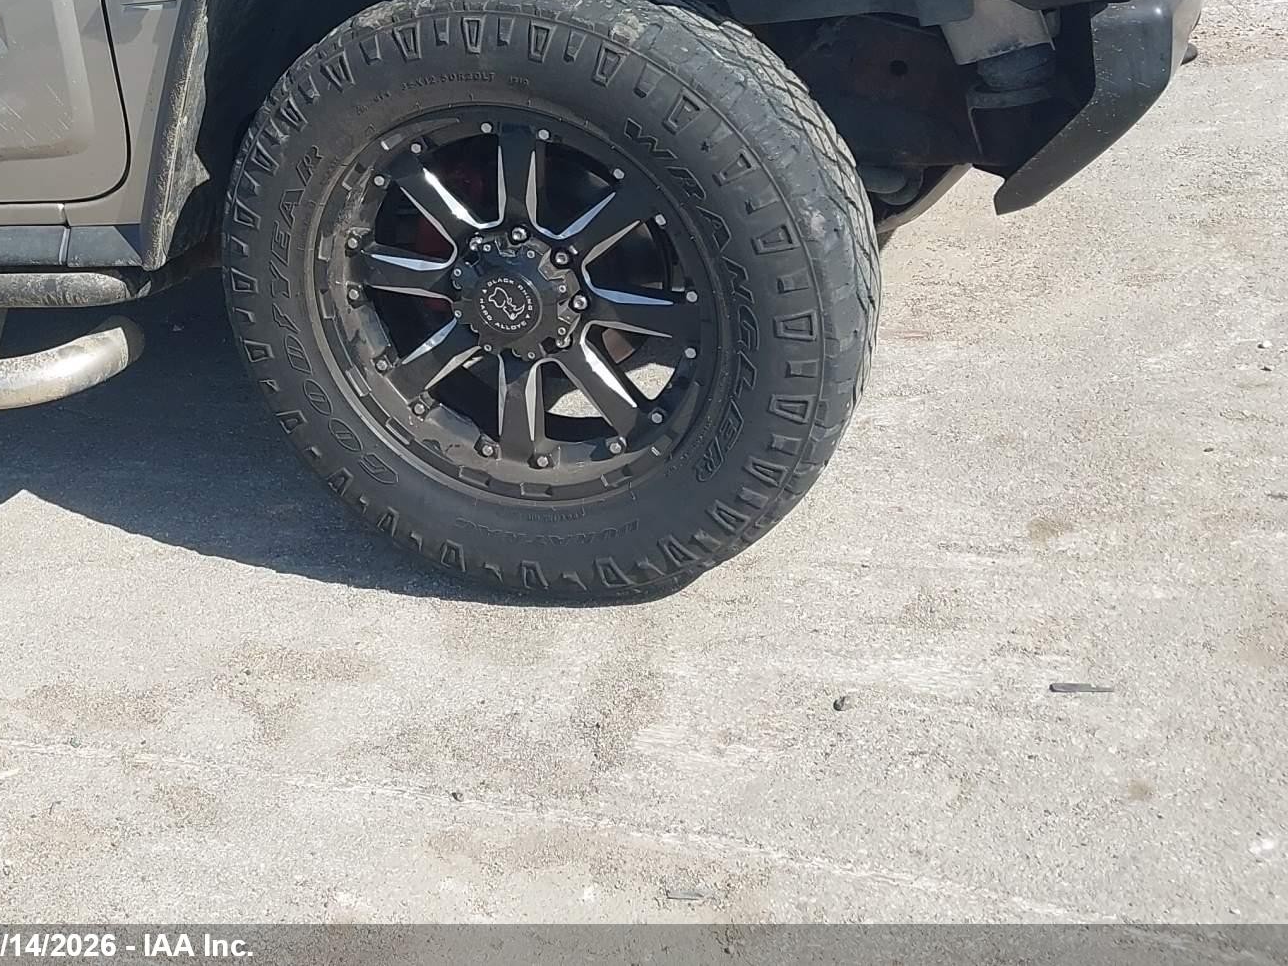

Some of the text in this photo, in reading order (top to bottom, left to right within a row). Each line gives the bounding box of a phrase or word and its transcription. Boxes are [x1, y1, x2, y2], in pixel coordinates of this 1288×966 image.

[269, 144, 399, 484] GOODYEAR
[487, 277, 515, 287] BLACK
[623, 117, 761, 483] WRANGLER
